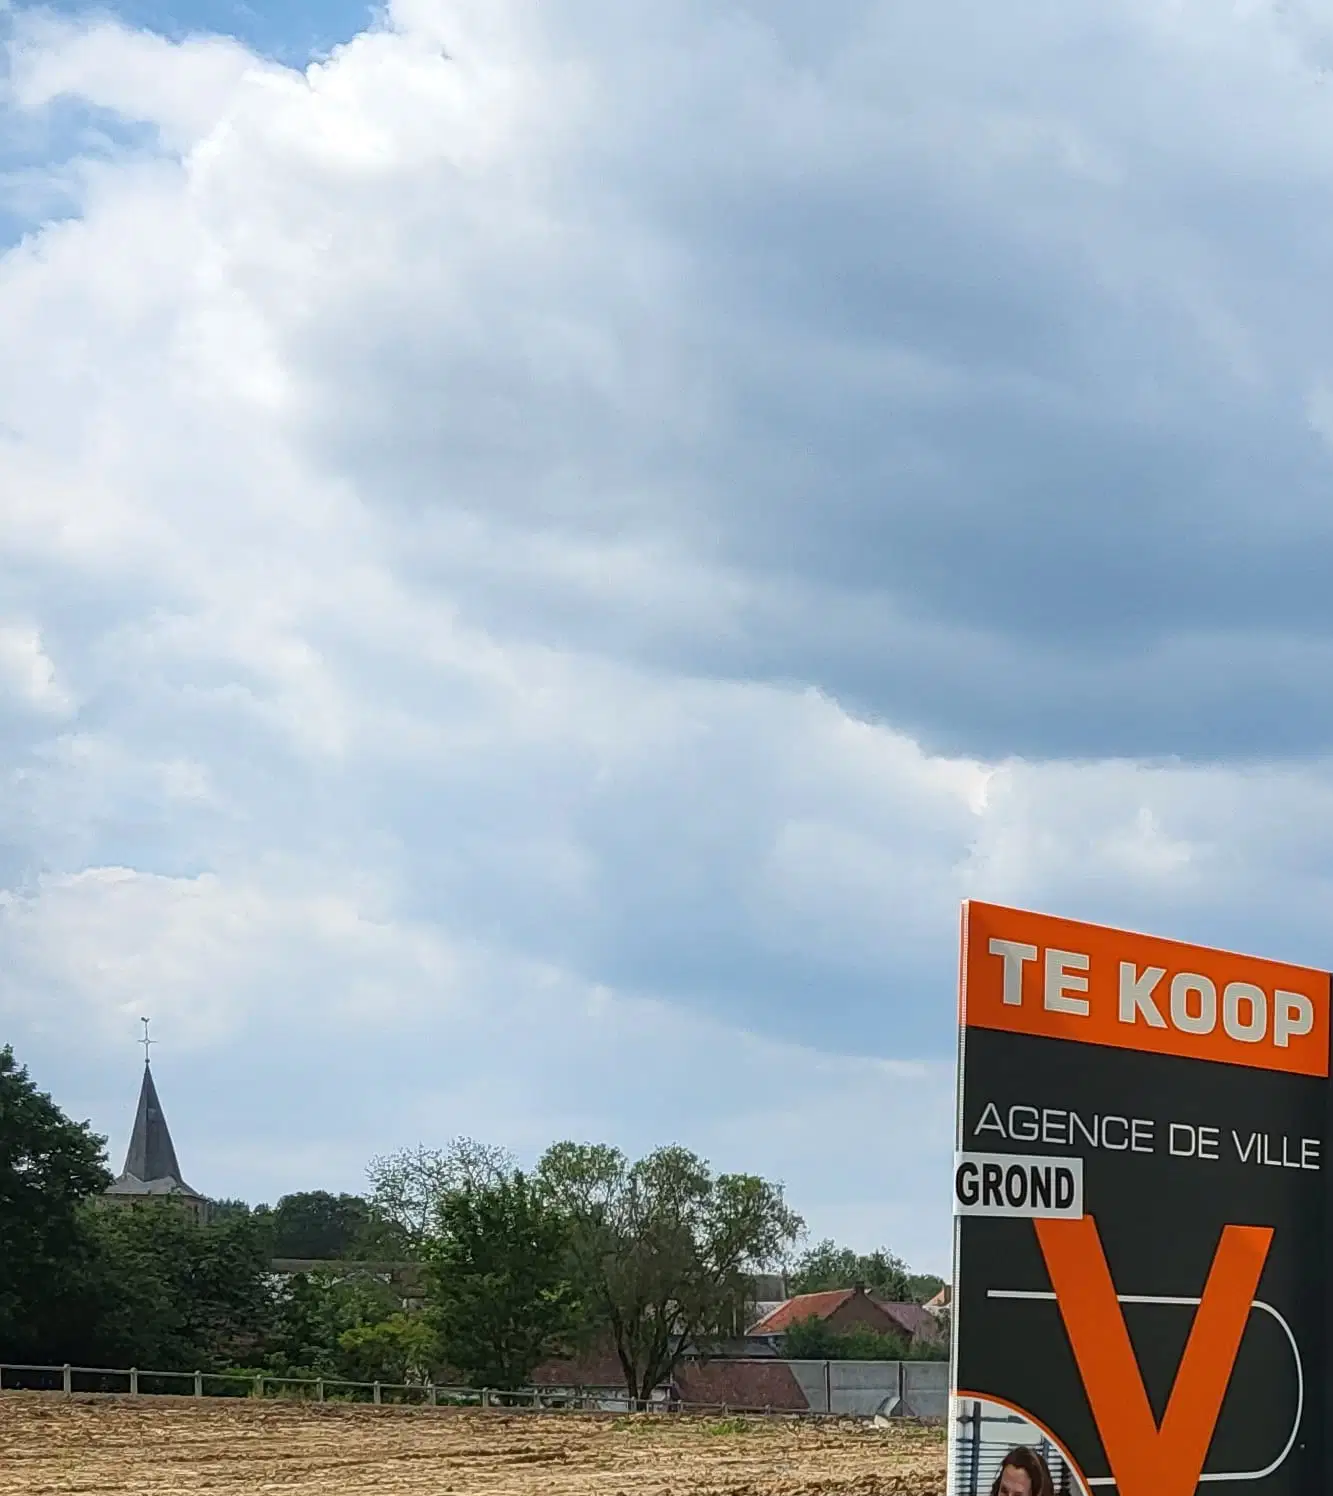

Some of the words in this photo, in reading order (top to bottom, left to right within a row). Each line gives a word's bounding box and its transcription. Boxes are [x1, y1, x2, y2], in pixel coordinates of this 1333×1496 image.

[988, 938, 1090, 1016] TE
[1118, 961, 1314, 1047] KOOP
[973, 1102, 1154, 1153] AGENCE
[1169, 1123, 1219, 1159] DE
[1231, 1129, 1321, 1170] VILLE
[955, 1162, 1075, 1209] GROND
